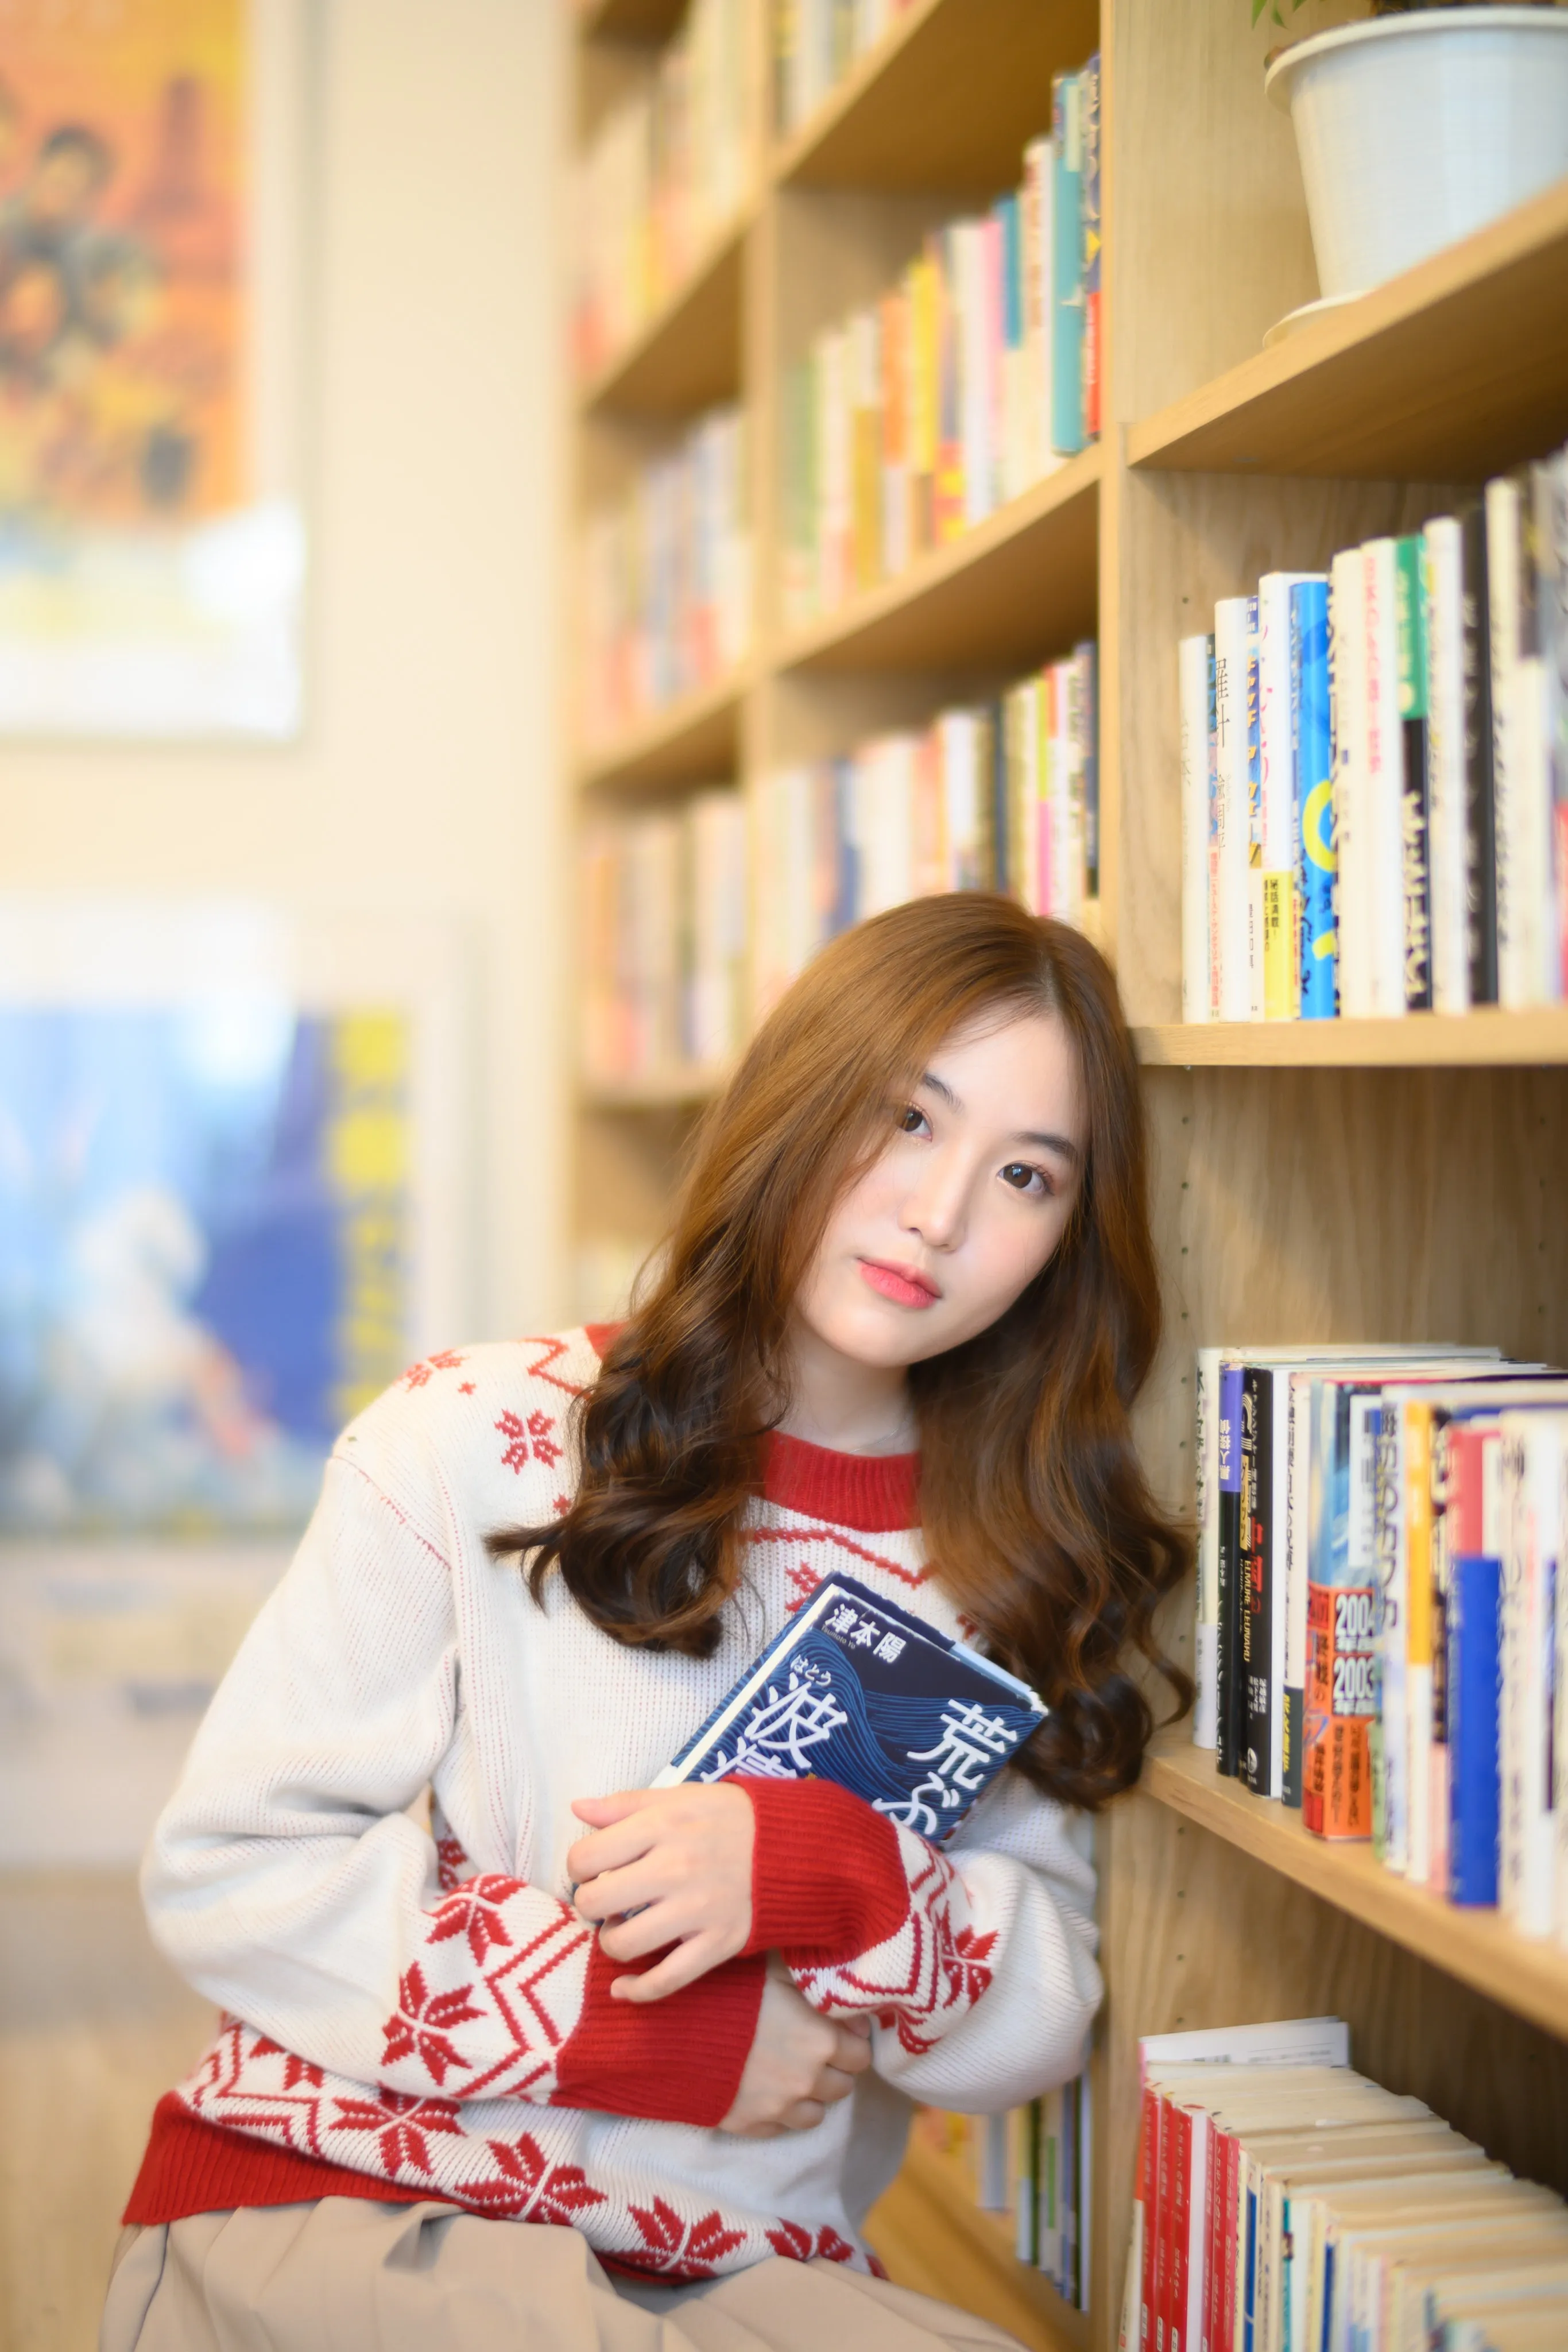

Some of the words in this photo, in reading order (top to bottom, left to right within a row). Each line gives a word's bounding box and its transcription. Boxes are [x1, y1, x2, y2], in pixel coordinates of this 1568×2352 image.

[1219, 1419, 1231, 1480] 黒人探偵
[821, 1626, 847, 1645] Tsumoto
[847, 1639, 857, 1650] Yo
[825, 1603, 907, 1663] 津本陽
[790, 1654, 831, 1686] はとう
[1333, 1656, 1375, 1699] 2003
